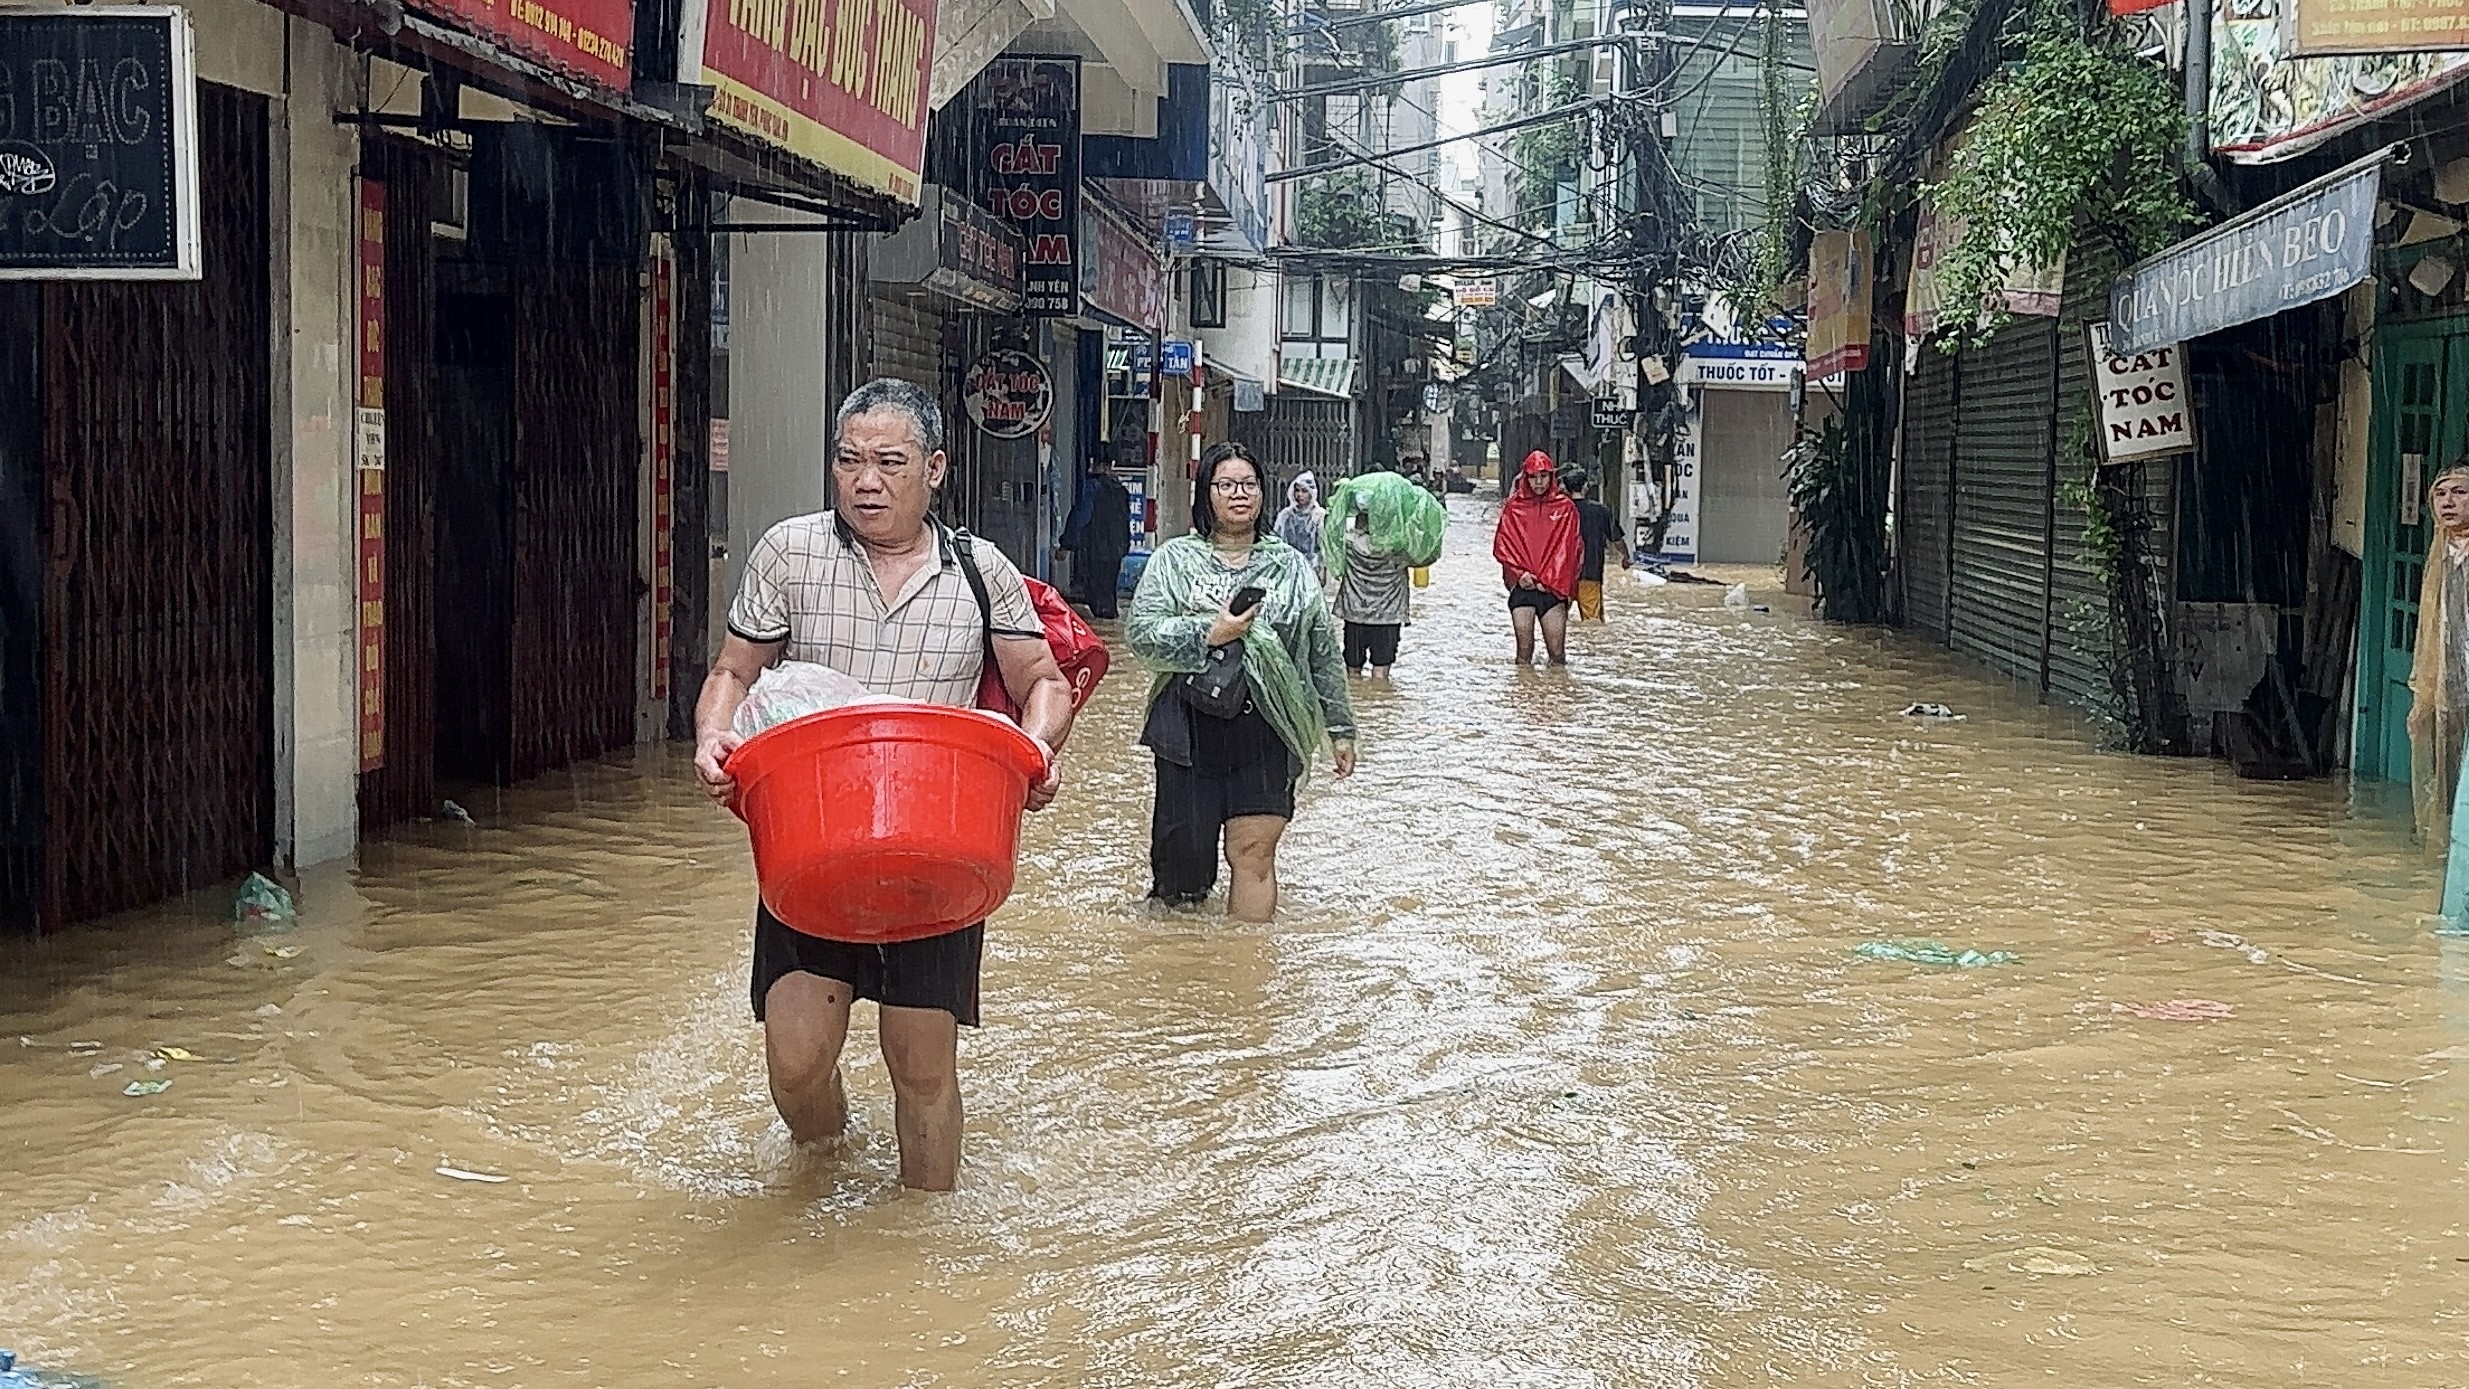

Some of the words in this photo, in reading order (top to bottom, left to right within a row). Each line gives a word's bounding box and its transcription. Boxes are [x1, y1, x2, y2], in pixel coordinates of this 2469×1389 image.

[33, 57, 150, 159] BẠC
[990, 133, 1062, 175] CẮT
[987, 182, 1062, 221] TÓC
[2281, 202, 2346, 268] BÉO
[1698, 362, 1745, 380] THUỐC
[1749, 362, 1776, 381] TỐT
[2110, 376, 2176, 408] TÓC
[986, 401, 1026, 421] NAM
[2110, 412, 2183, 442] NAM
